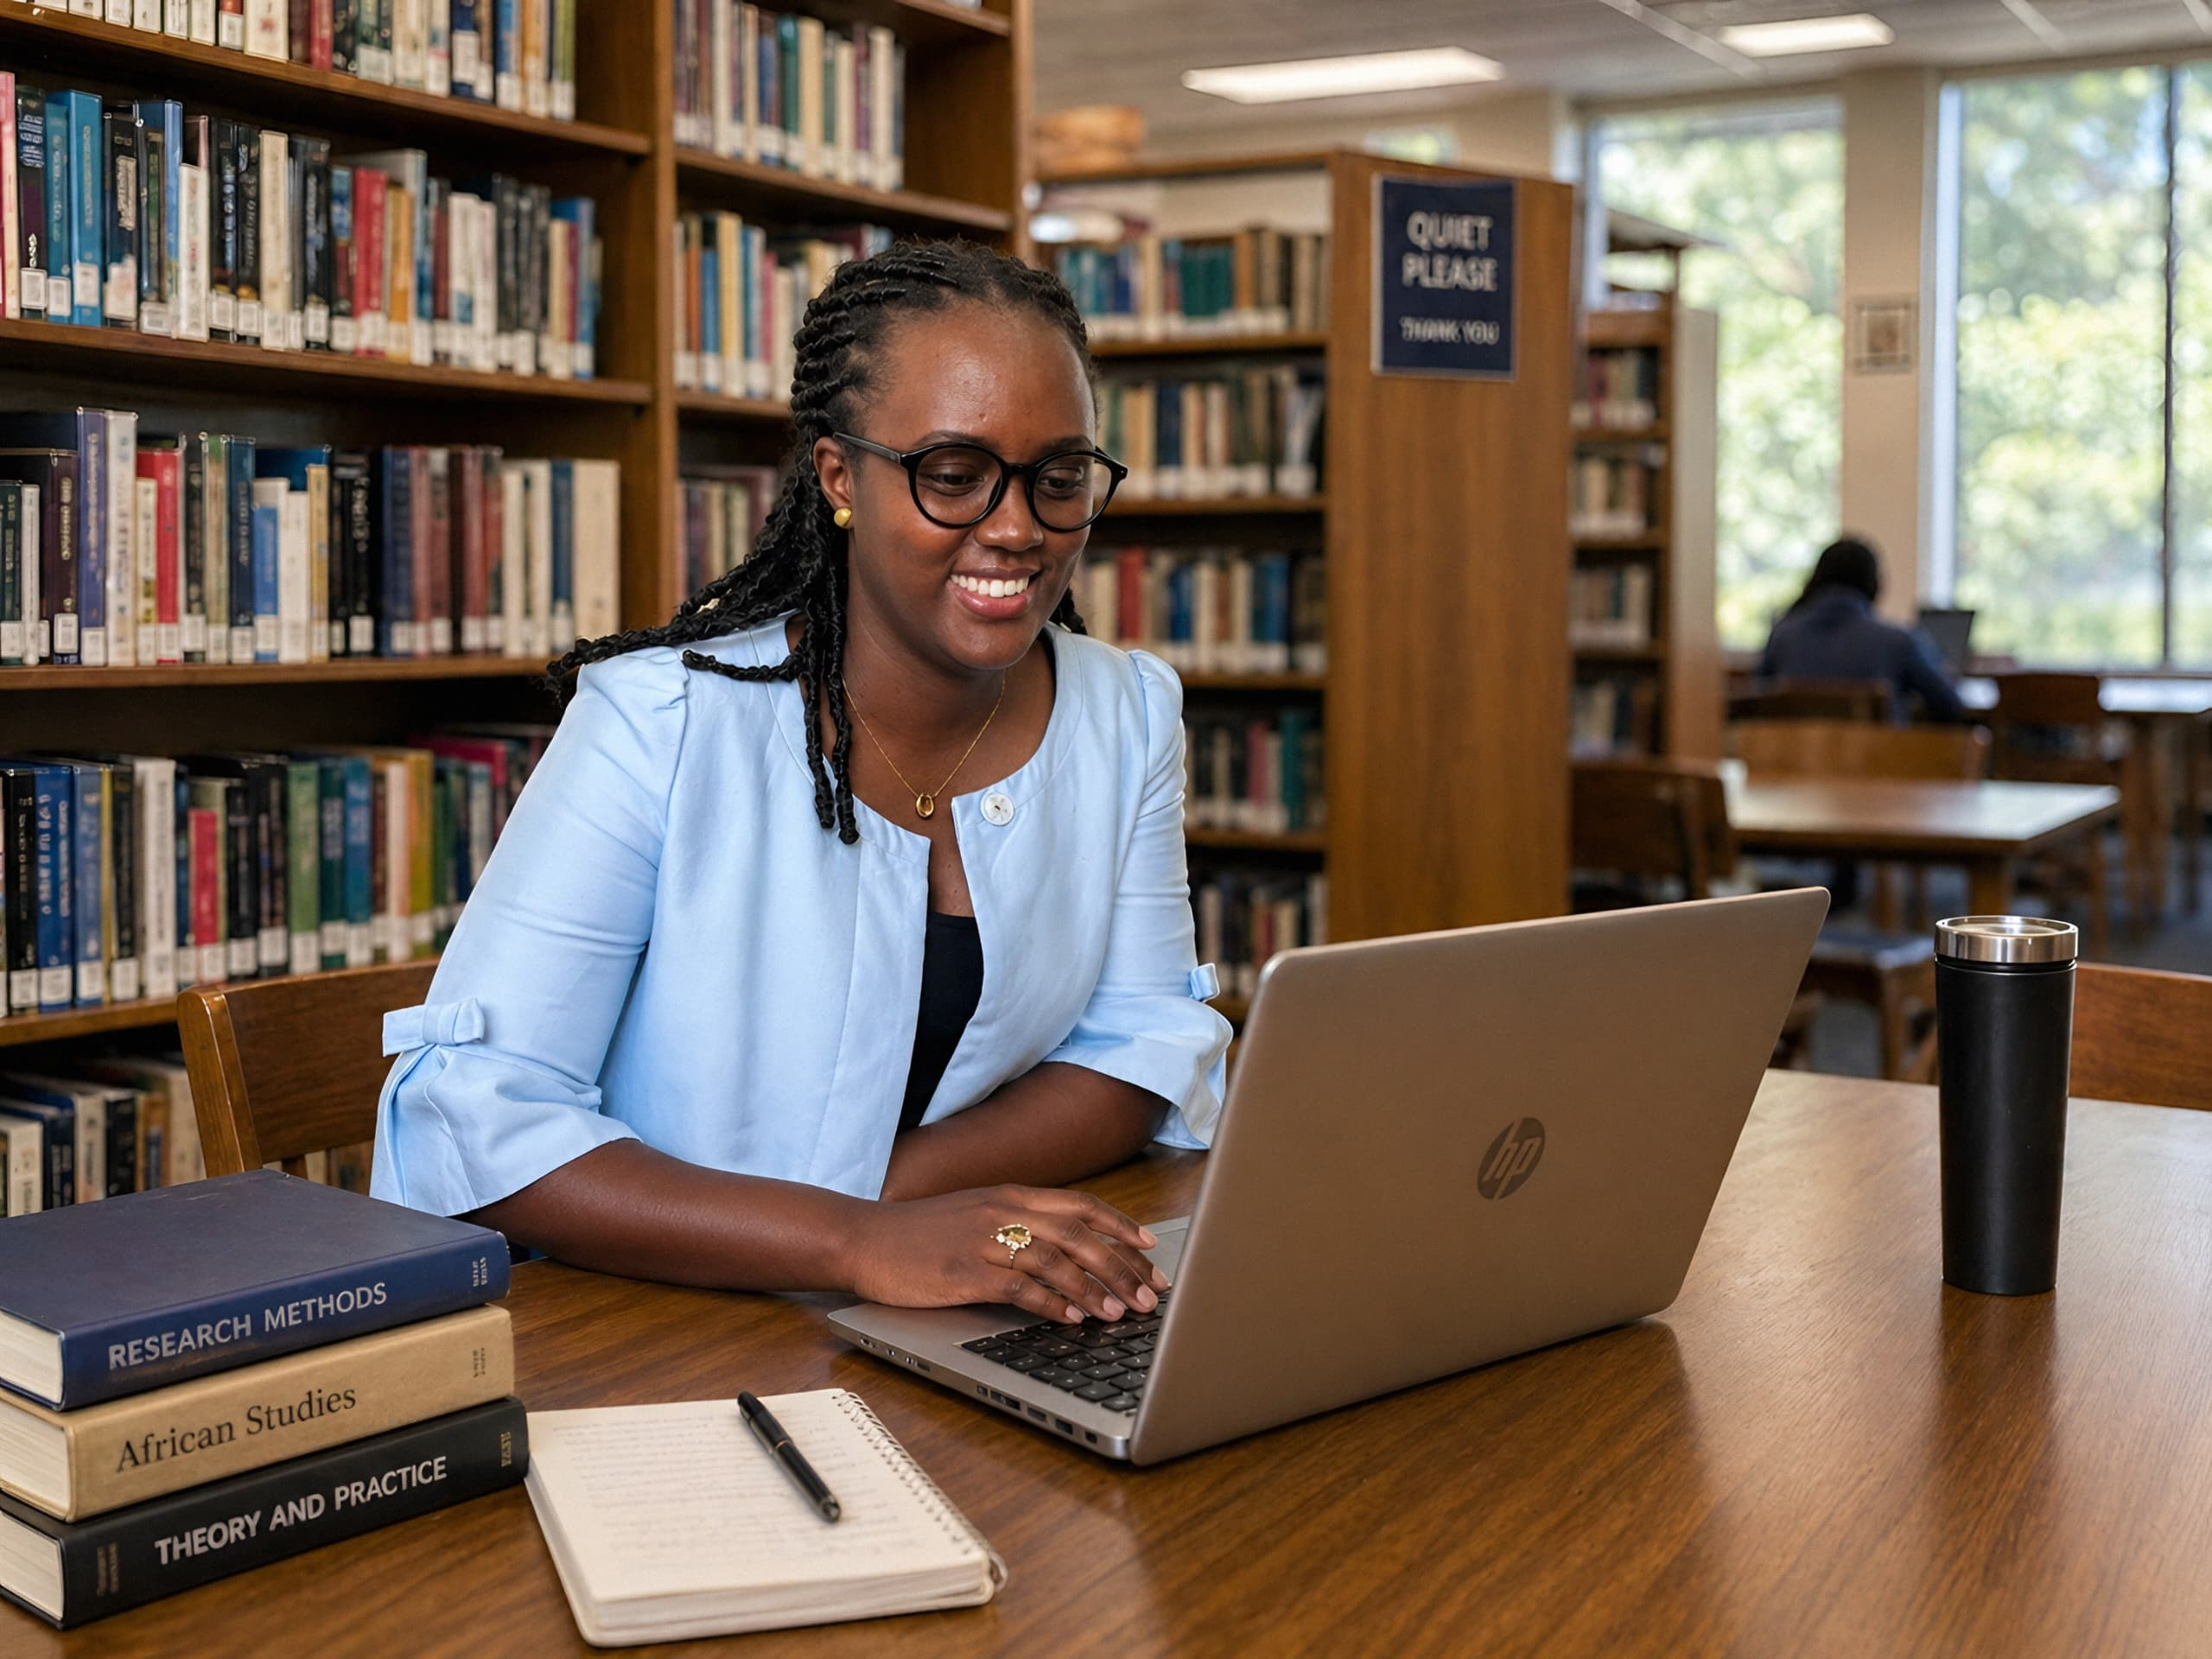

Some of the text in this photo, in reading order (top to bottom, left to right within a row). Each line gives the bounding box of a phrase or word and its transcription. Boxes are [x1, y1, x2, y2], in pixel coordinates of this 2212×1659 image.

[1402, 252, 1498, 292] PLEASE
[1407, 211, 1493, 251] QUIET
[1479, 1119, 1543, 1202] hp
[108, 1281, 388, 1370] RESEARCH METHODS
[116, 1387, 357, 1472] African Studies
[155, 1456, 448, 1566] THEORY AND PRACTICE
